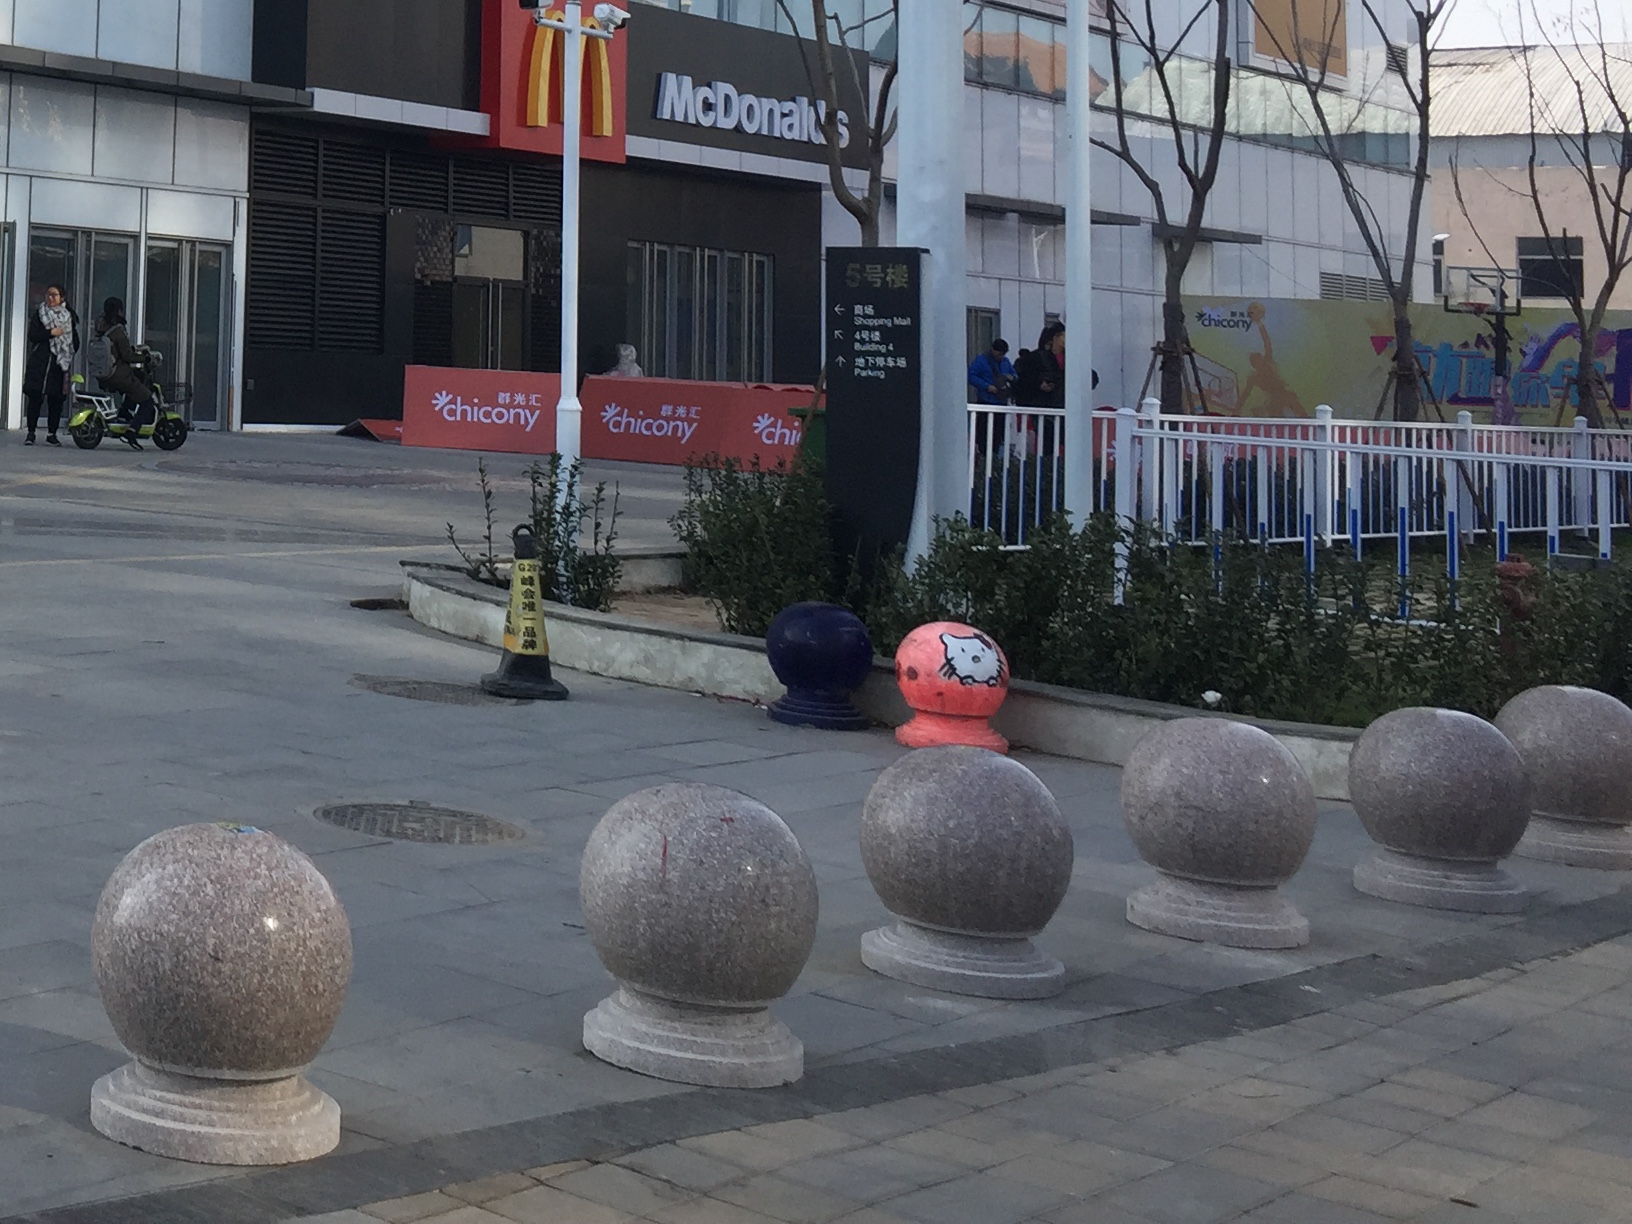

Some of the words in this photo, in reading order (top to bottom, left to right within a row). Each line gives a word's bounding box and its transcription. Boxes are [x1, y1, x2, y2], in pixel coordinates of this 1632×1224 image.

[656, 72, 850, 149] McDonalds
[846, 263, 909, 289] 5号楼
[853, 317, 892, 328] Shopping
[893, 316, 912, 326] Mall
[1201, 314, 1252, 332] chicony
[854, 330, 881, 342] 4号楼
[854, 342, 887, 353] Building
[887, 342, 894, 352] 4
[854, 356, 907, 368] 地下停车场
[854, 368, 886, 379] Parking
[497, 391, 542, 407] 群光汇
[442, 395, 541, 432] chicony
[660, 403, 702, 419] 群光汇
[607, 407, 698, 444] chicony
